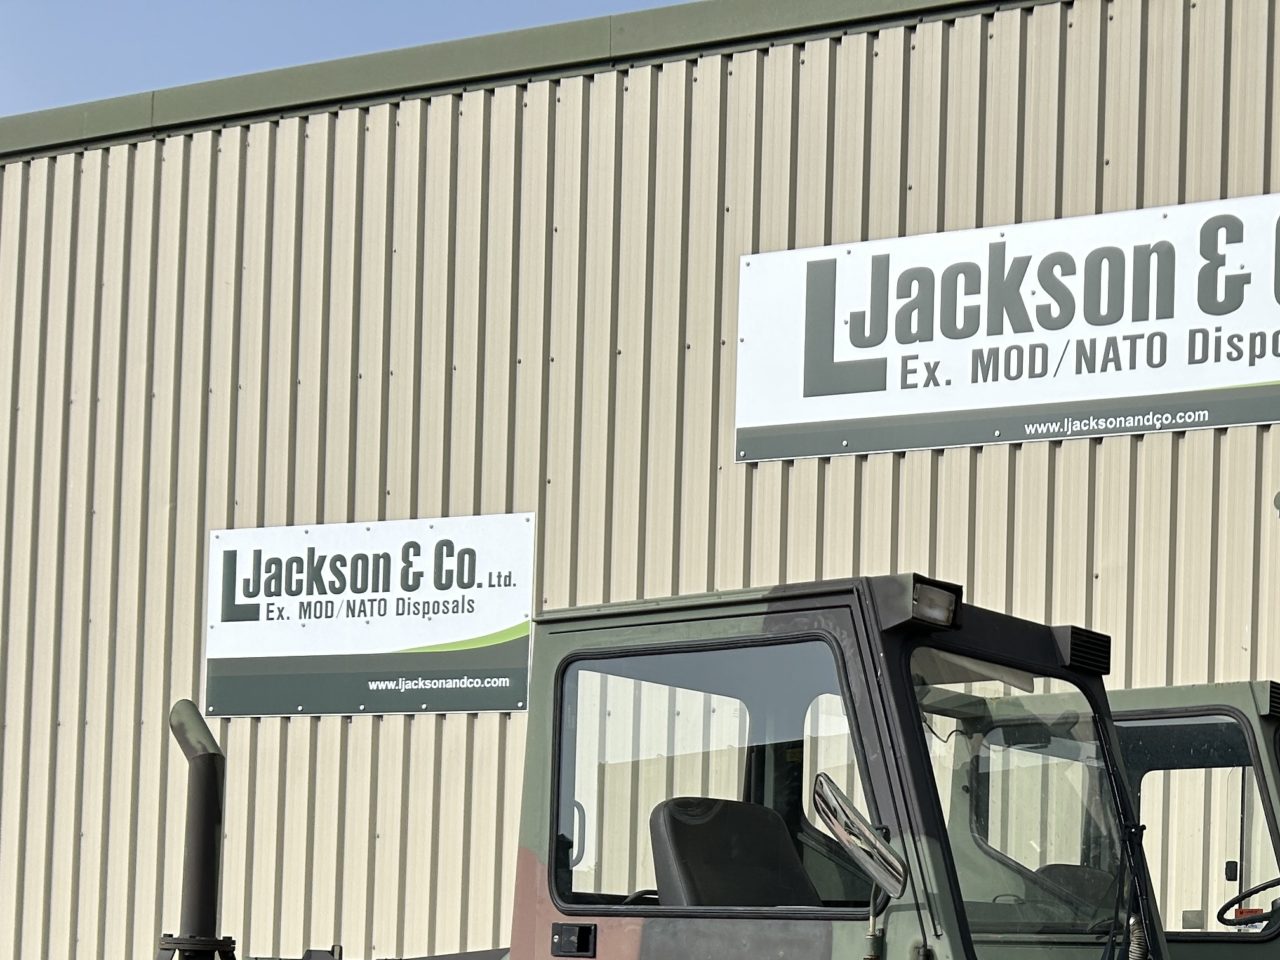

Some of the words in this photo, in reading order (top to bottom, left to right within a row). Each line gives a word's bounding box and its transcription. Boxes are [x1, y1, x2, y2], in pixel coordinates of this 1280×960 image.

[1197, 214, 1251, 316] &
[901, 354, 951, 389] Ex.
[971, 332, 1167, 383] MOD/NATO
[1025, 410, 1209, 435] www.ljacksonandco.com
[400, 541, 424, 592] &
[434, 539, 482, 591] Co.
[488, 571, 516, 588] Ltd.
[266, 602, 290, 621] Ex.
[299, 598, 387, 619] MOD/NATO
[396, 595, 475, 619] Disposals
[368, 676, 510, 692] www.ljacksonandco.com
